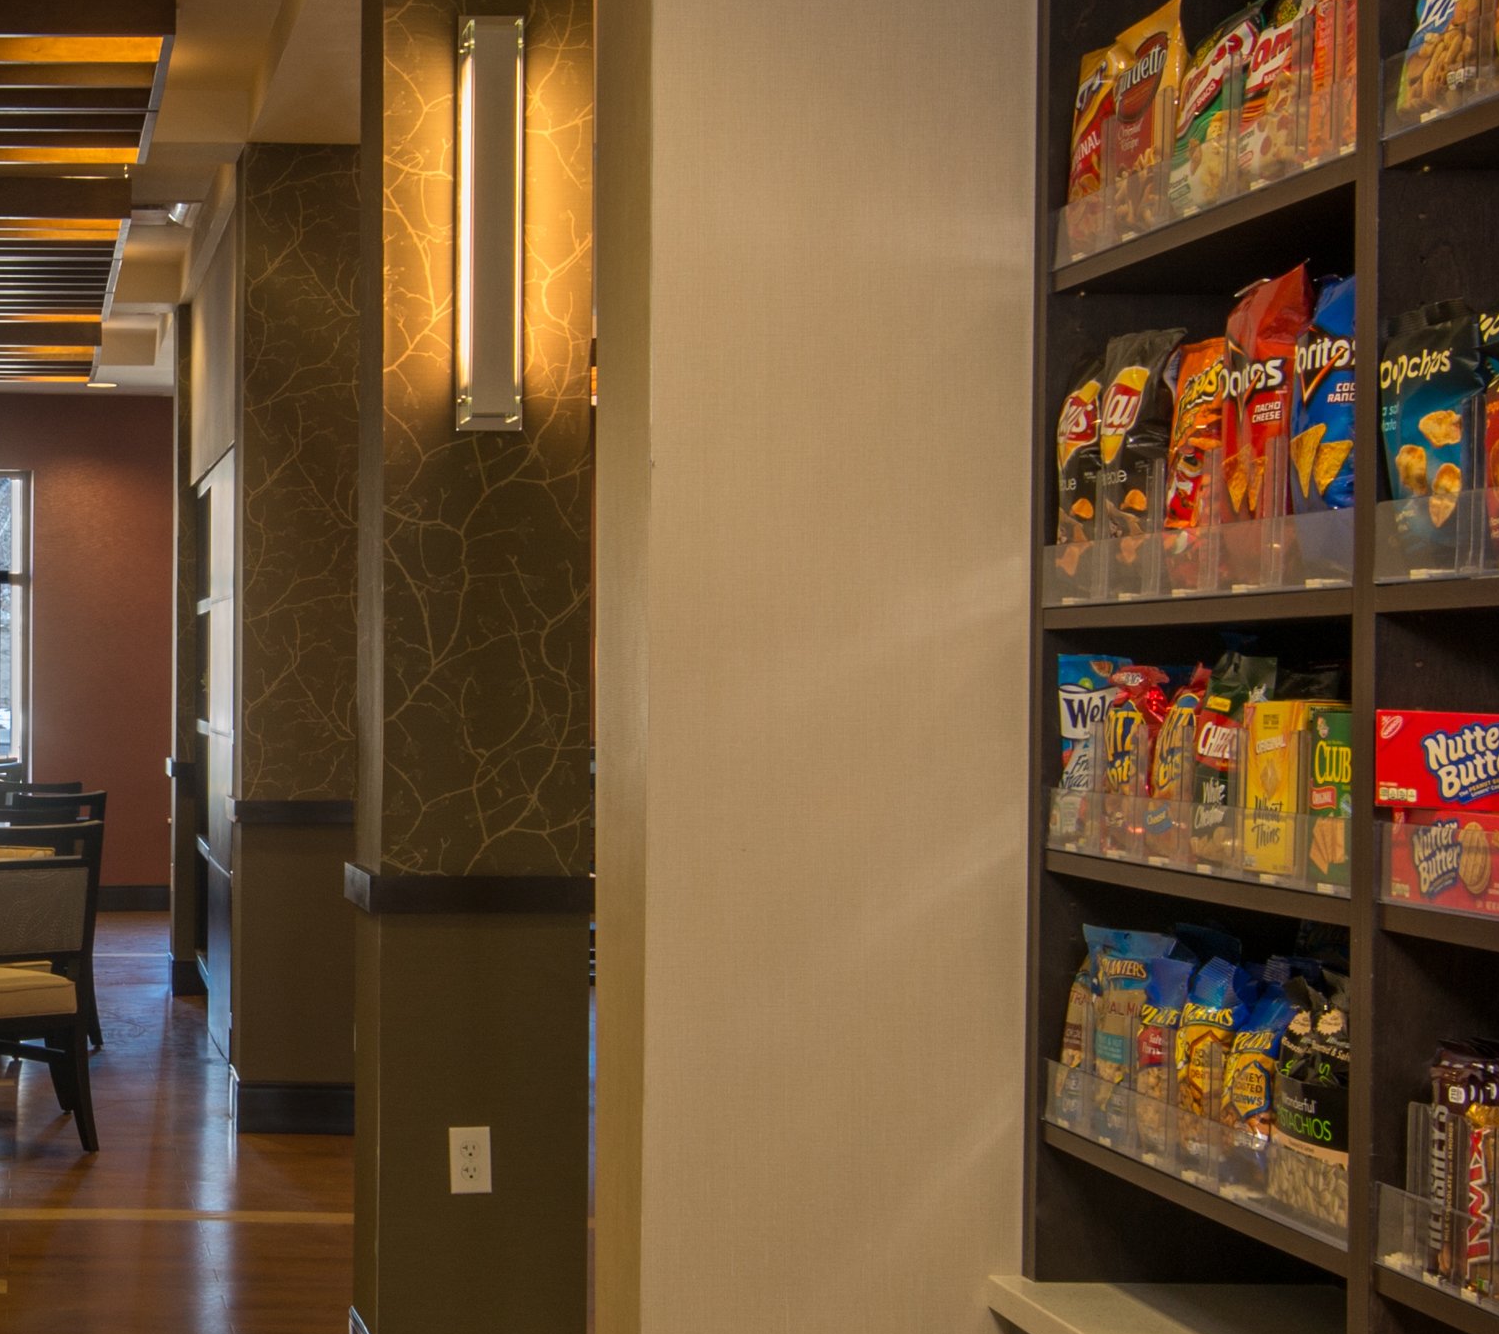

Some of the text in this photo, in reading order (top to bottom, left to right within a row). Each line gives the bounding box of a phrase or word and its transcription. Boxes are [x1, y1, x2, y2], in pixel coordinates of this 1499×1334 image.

[1251, 409, 1282, 424] CHEESE
[1254, 400, 1283, 414] NACHO
[1314, 740, 1352, 785] CLUB
[1252, 822, 1282, 851] Thins
